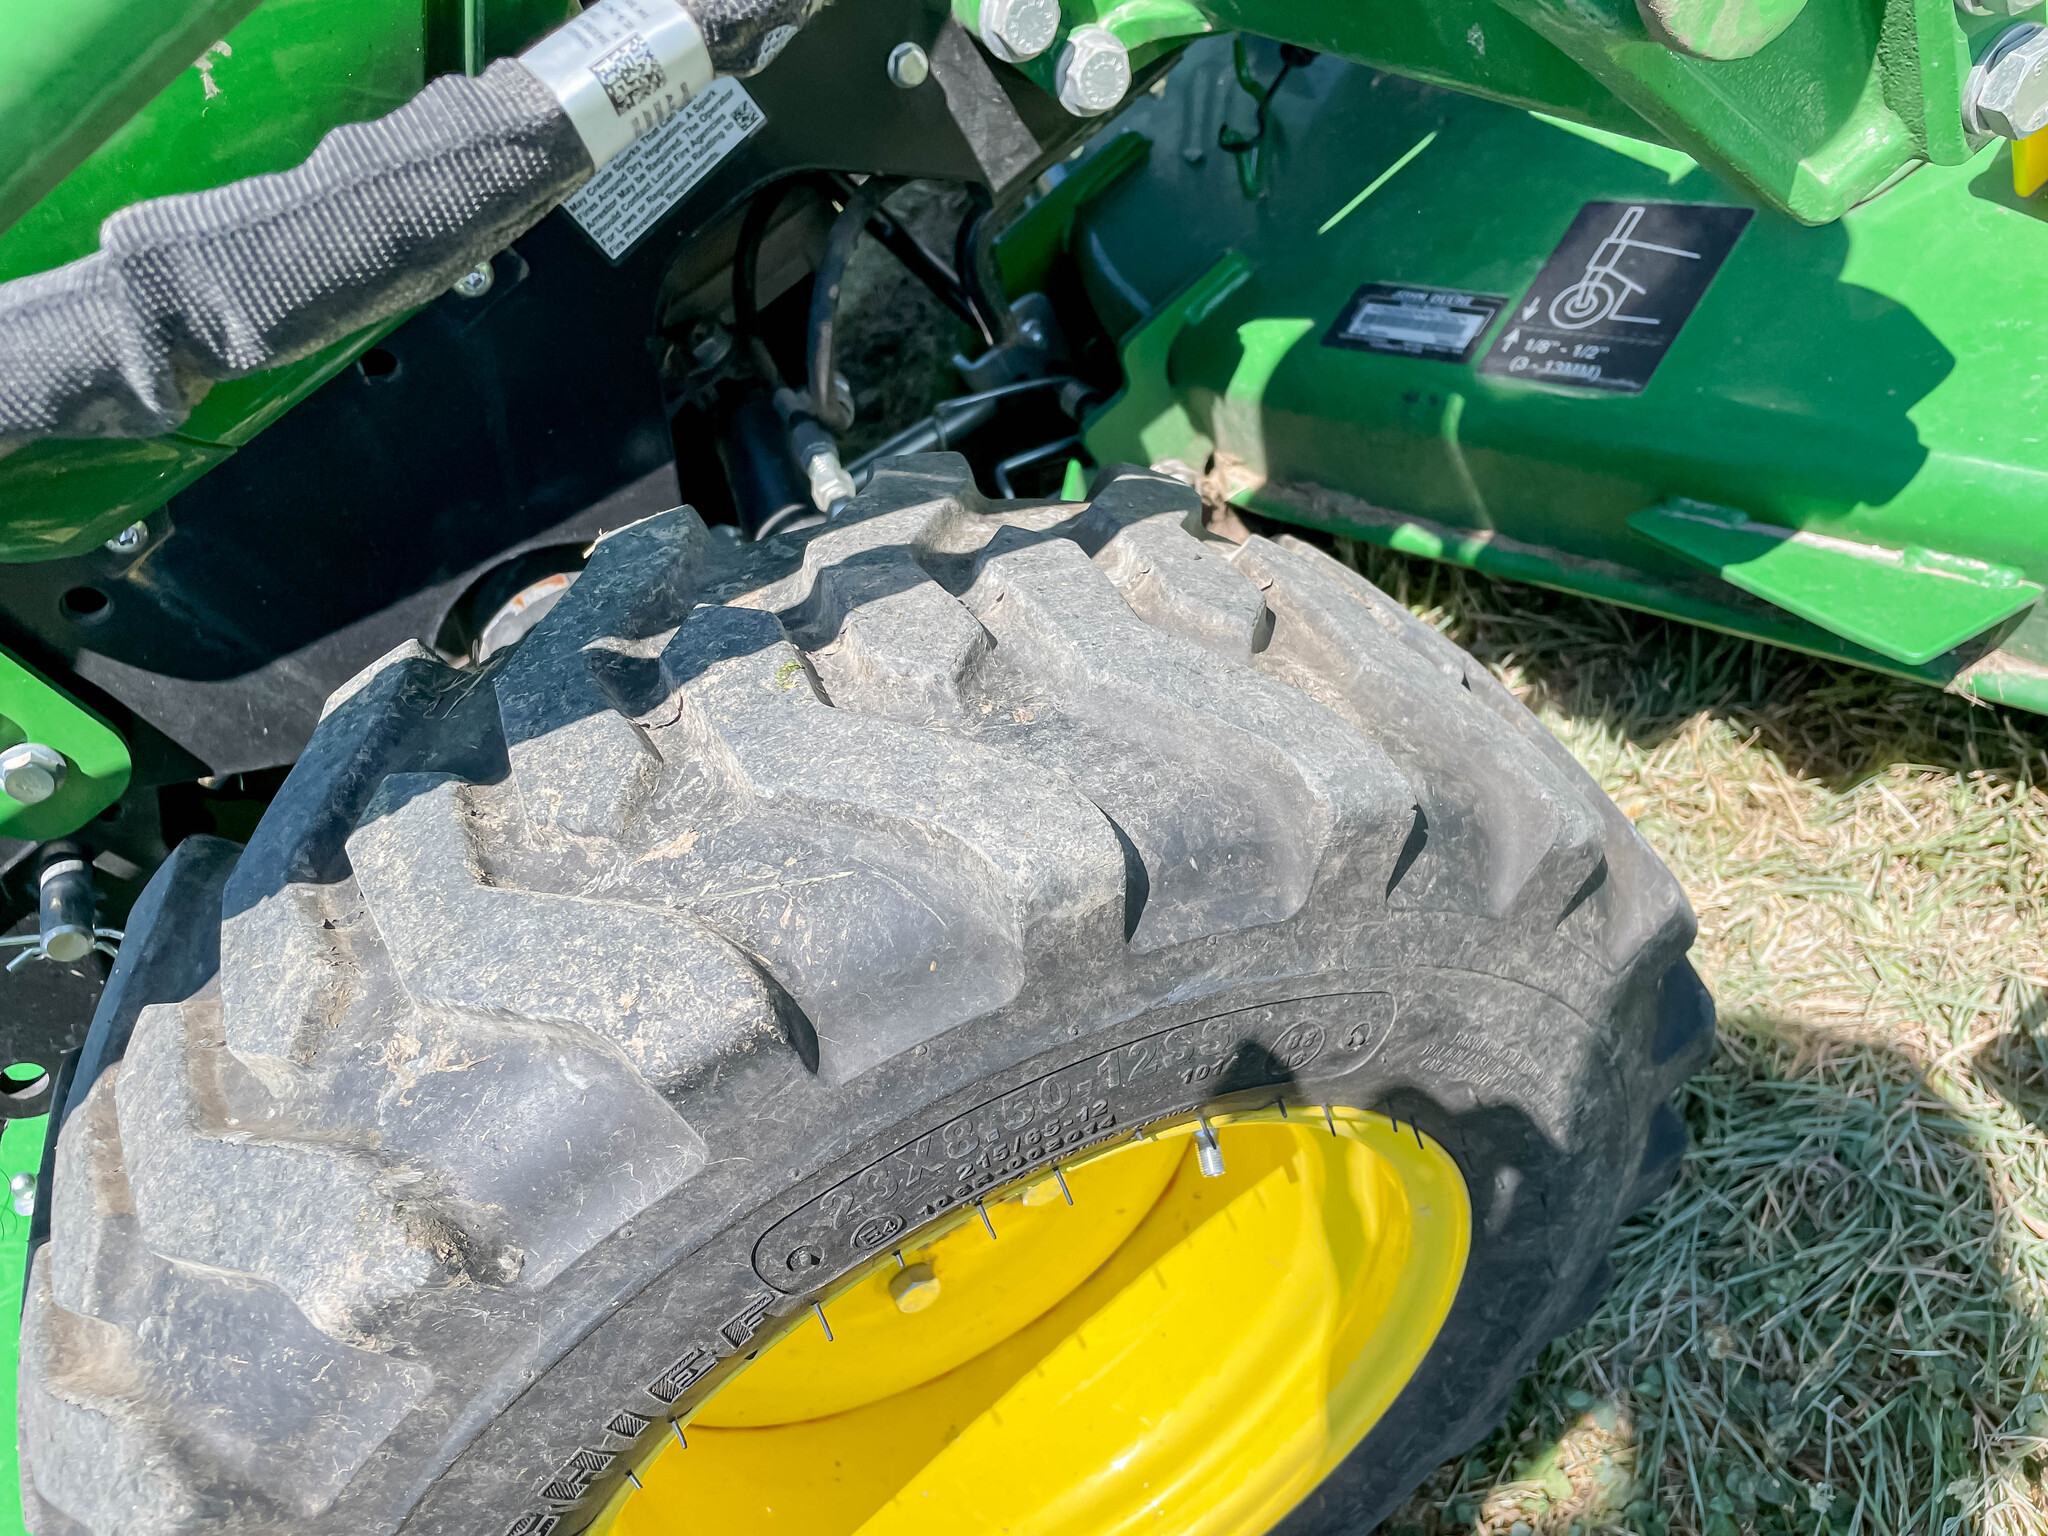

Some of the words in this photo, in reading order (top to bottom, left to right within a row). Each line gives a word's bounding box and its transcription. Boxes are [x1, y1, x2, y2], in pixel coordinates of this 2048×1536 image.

[568, 195, 587, 213] May
[585, 170, 613, 196] Create
[612, 144, 642, 172] Sparks
[640, 126, 660, 145] That
[576, 200, 597, 221] Fires
[596, 172, 627, 201] Around
[626, 158, 643, 175] Dry
[684, 111, 692, 119] A
[692, 89, 717, 112] Spark
[585, 198, 618, 229] Arrestor
[617, 182, 636, 200] May
[634, 171, 646, 183] be
[683, 121, 699, 136] The
[698, 88, 735, 122] Operator
[592, 210, 621, 237] Should
[620, 181, 652, 211] Contact
[651, 160, 674, 182] Local
[673, 145, 690, 162] Fire
[689, 112, 727, 148] Agencies
[600, 232, 615, 246] For
[614, 212, 636, 233] Laws
[636, 203, 647, 214] or
[645, 160, 693, 204] Regulations
[691, 129, 726, 162] Relating
[724, 121, 734, 131] to
[609, 238, 626, 254] Fire
[624, 199, 667, 240] Prevention
[955, 1099, 1109, 1182] 215/65-12
